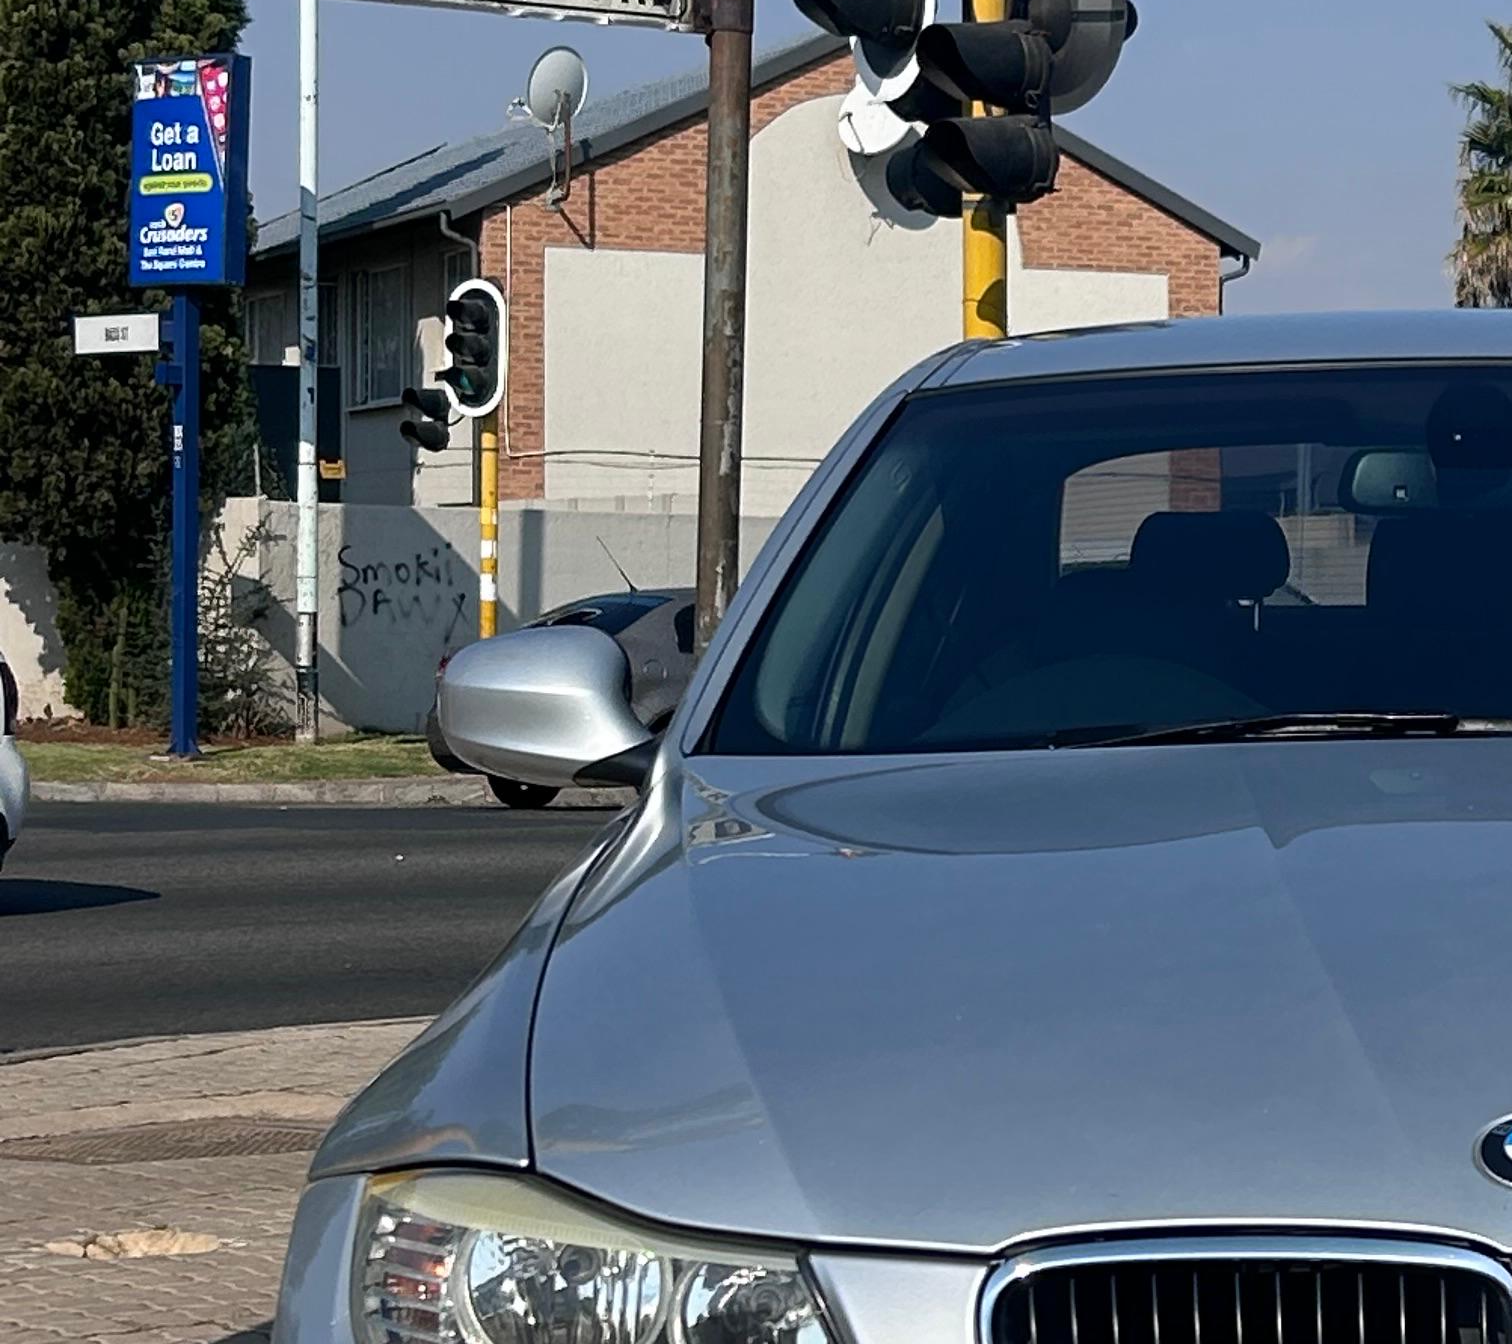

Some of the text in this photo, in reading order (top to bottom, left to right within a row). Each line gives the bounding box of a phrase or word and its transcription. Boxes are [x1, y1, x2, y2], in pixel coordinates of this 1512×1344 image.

[151, 122, 199, 146] Get a
[151, 148, 197, 171] Loan
[140, 224, 208, 244] Crusaders
